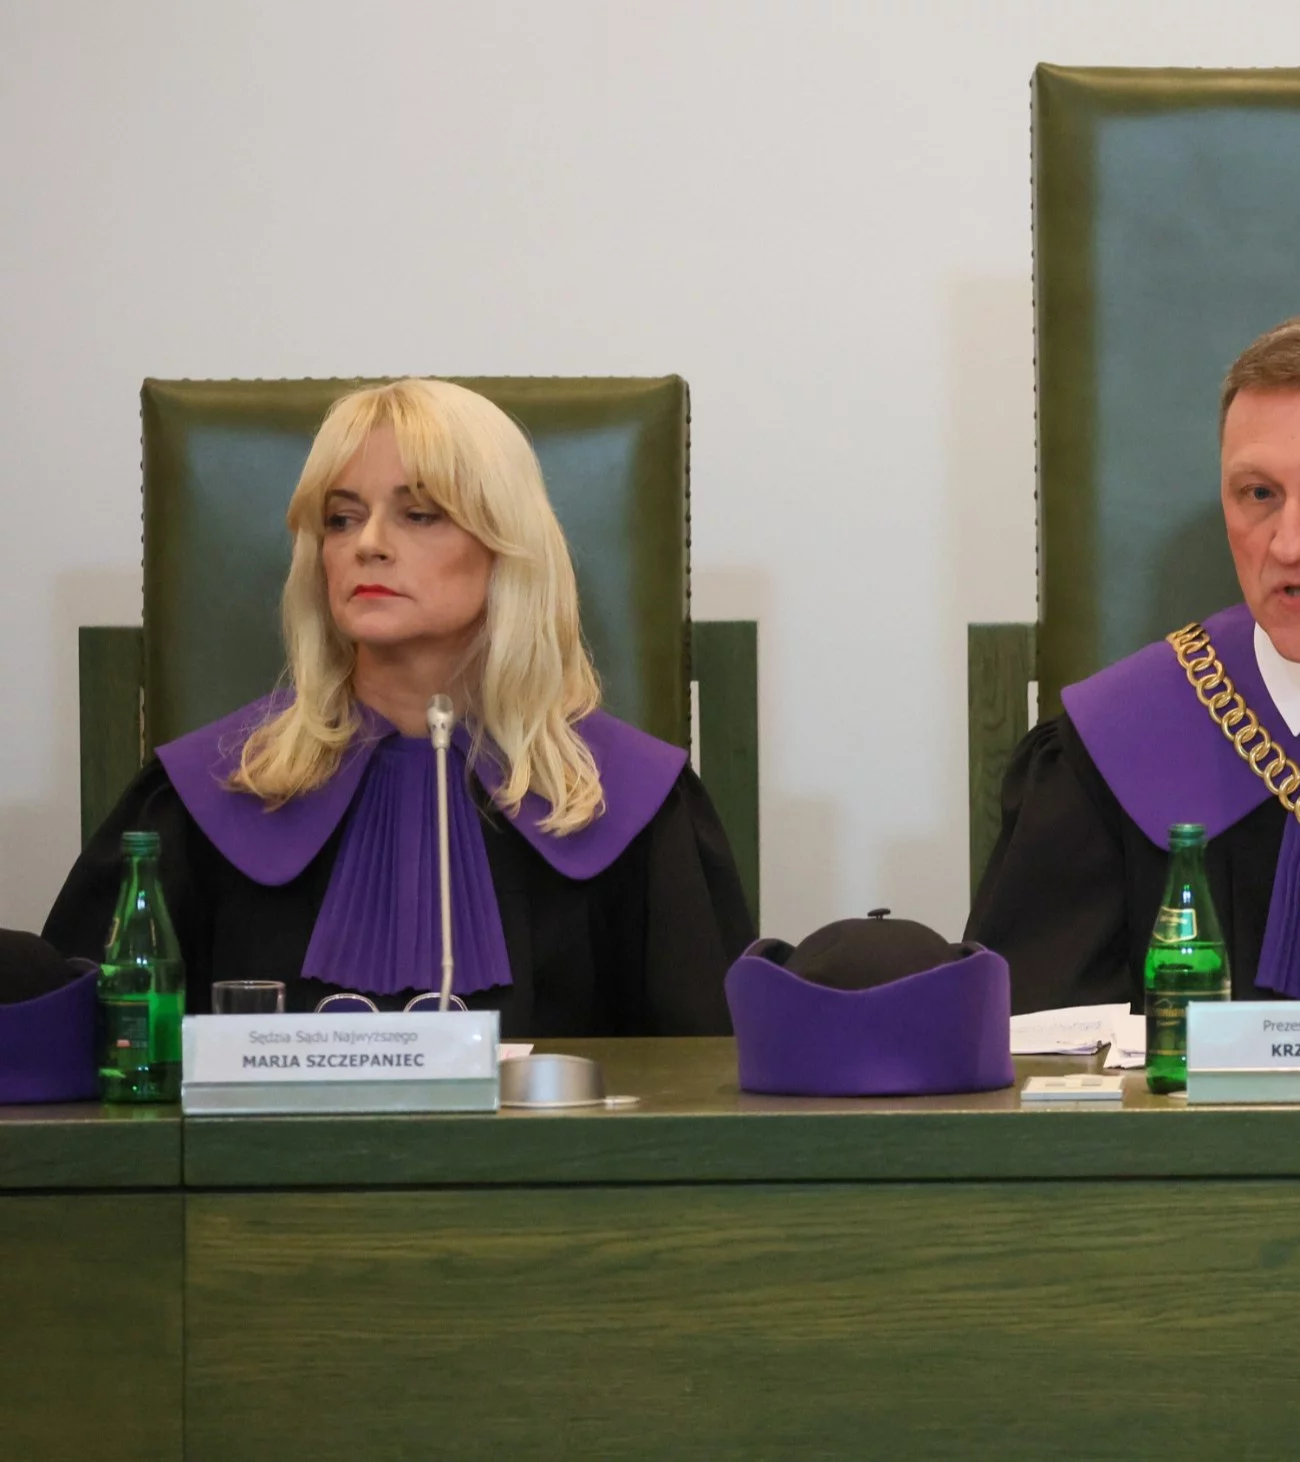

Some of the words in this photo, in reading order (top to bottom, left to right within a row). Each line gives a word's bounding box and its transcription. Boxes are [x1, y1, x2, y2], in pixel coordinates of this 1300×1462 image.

[249, 1030, 292, 1045] Sędzia
[295, 1029, 329, 1044] Sądu
[333, 1029, 418, 1045] Najwyższego
[242, 1054, 301, 1068] MARIA
[306, 1053, 425, 1068] SZCZEPANIEC
